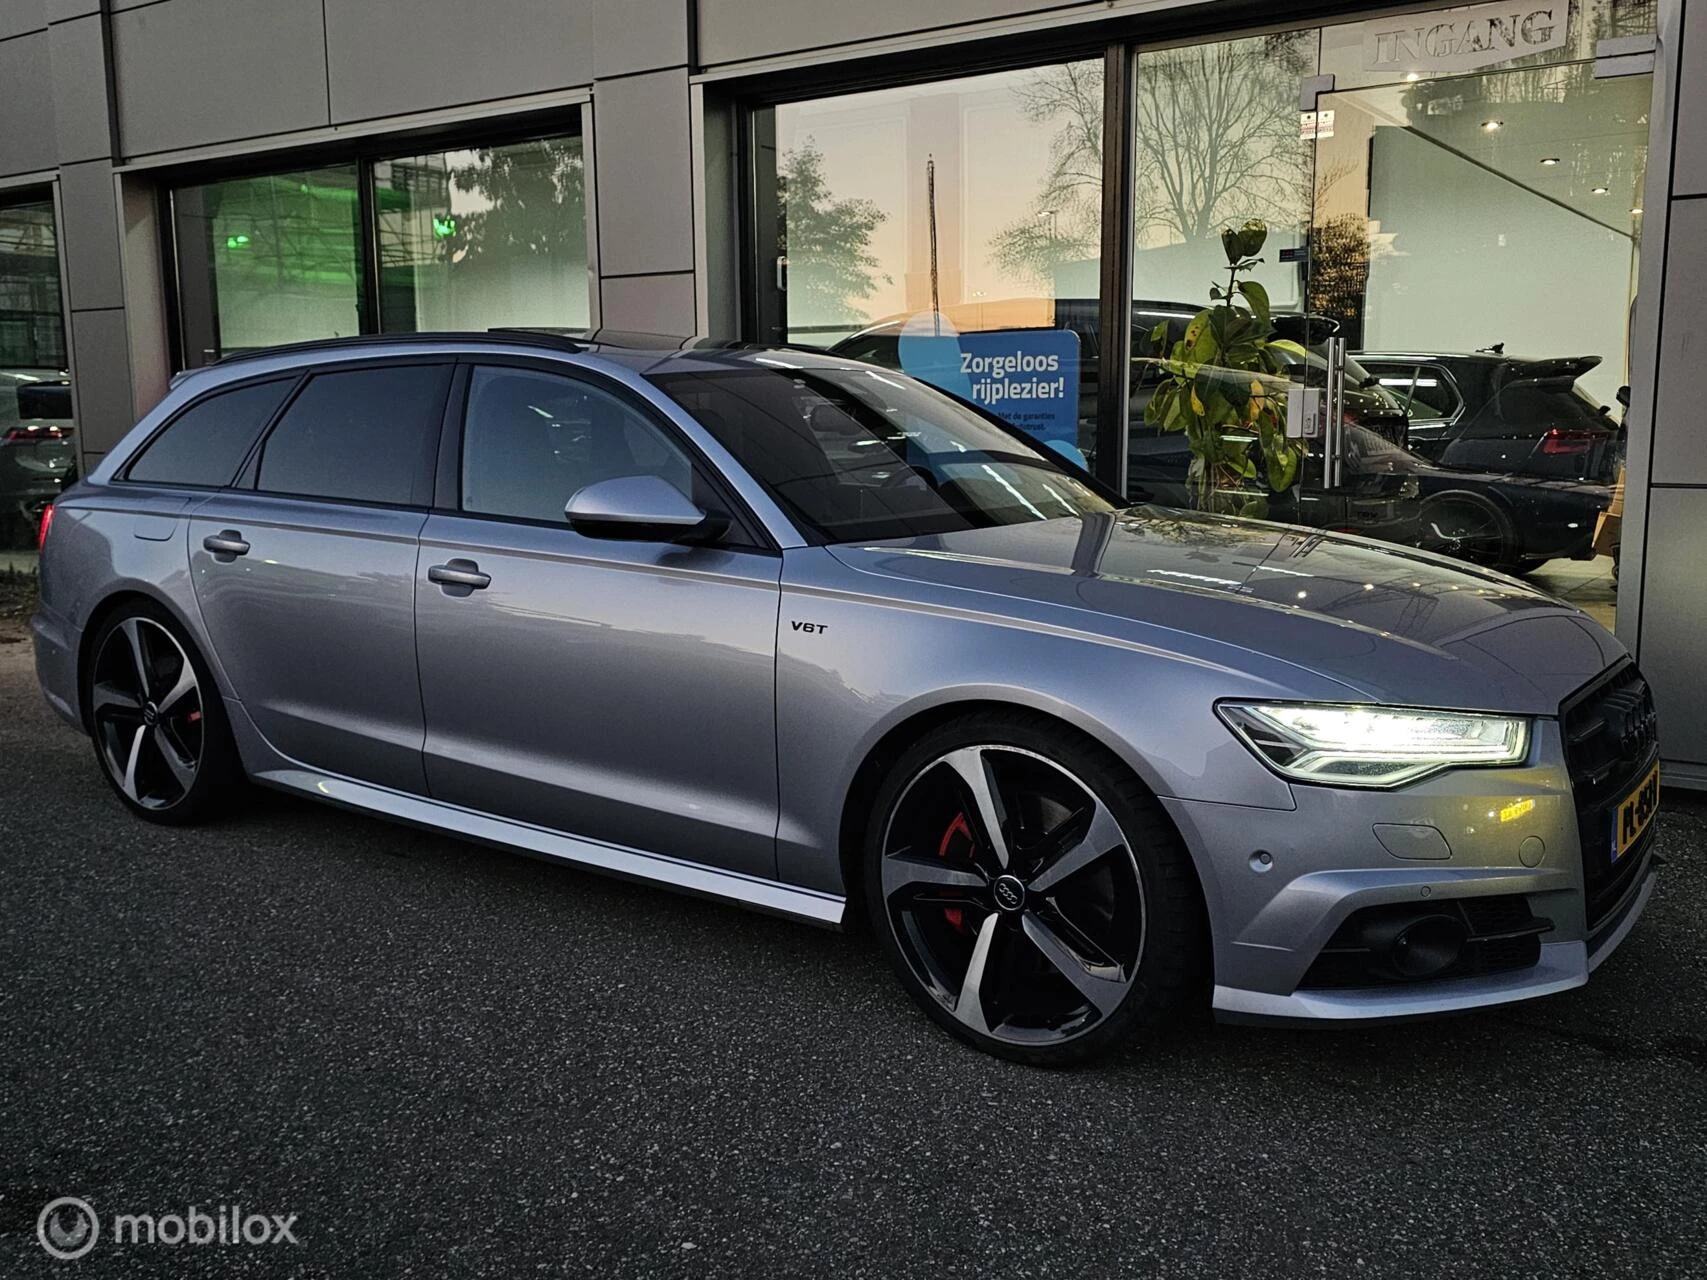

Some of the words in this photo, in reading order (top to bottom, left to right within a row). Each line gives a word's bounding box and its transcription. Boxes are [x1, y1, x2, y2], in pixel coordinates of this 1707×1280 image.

[1373, 10, 1556, 64] INGANG
[960, 350, 1059, 378] Zorgeloos
[972, 377, 1064, 405] rijplezier!
[791, 620, 828, 634] V6T
